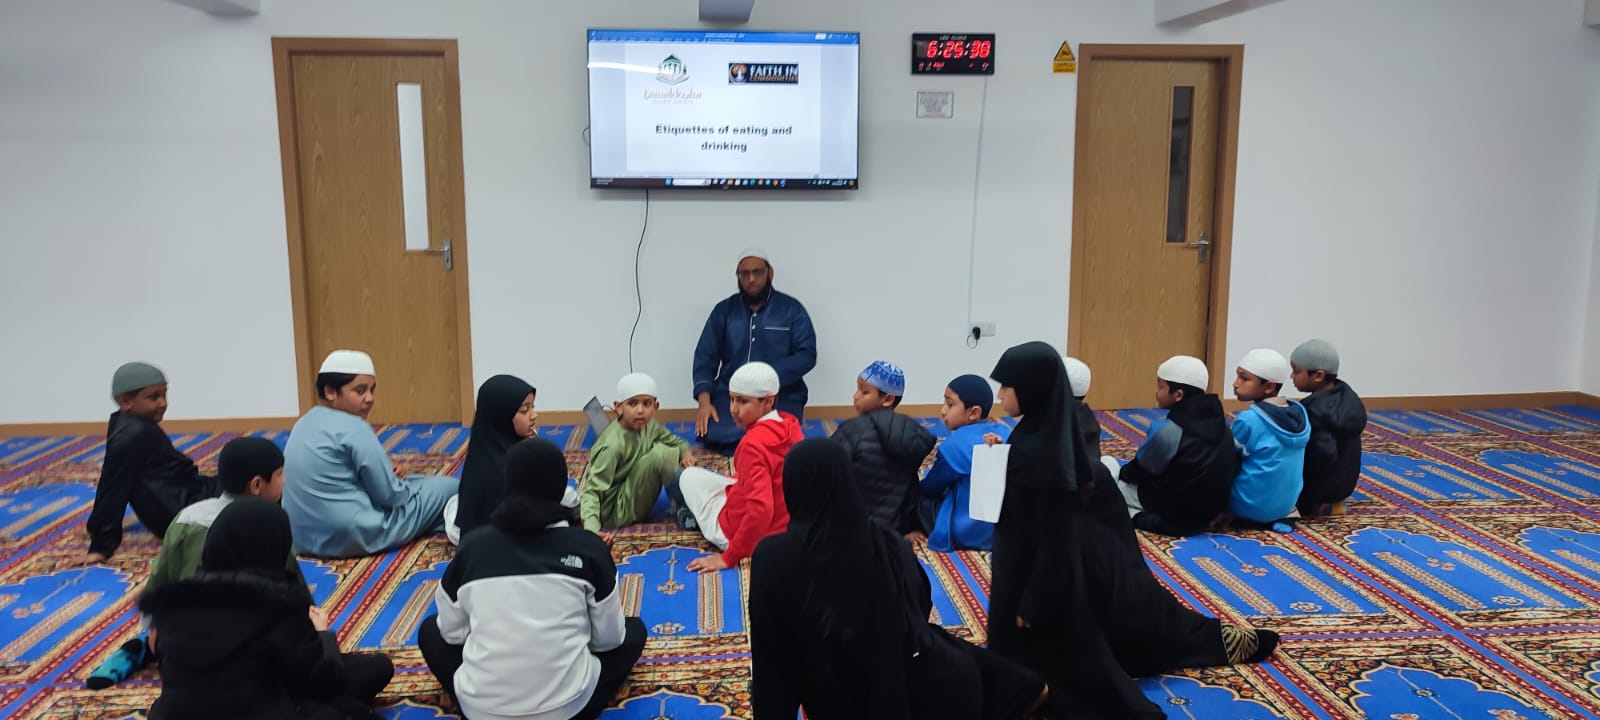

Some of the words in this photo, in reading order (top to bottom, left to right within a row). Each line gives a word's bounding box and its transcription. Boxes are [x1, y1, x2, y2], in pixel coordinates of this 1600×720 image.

[750, 64, 782, 76] FAITH
[785, 65, 799, 76] IN
[655, 124, 715, 137] Etiquettes
[718, 125, 730, 135] of
[732, 125, 769, 137] eating
[771, 125, 793, 135] and
[700, 140, 748, 153] drinking
